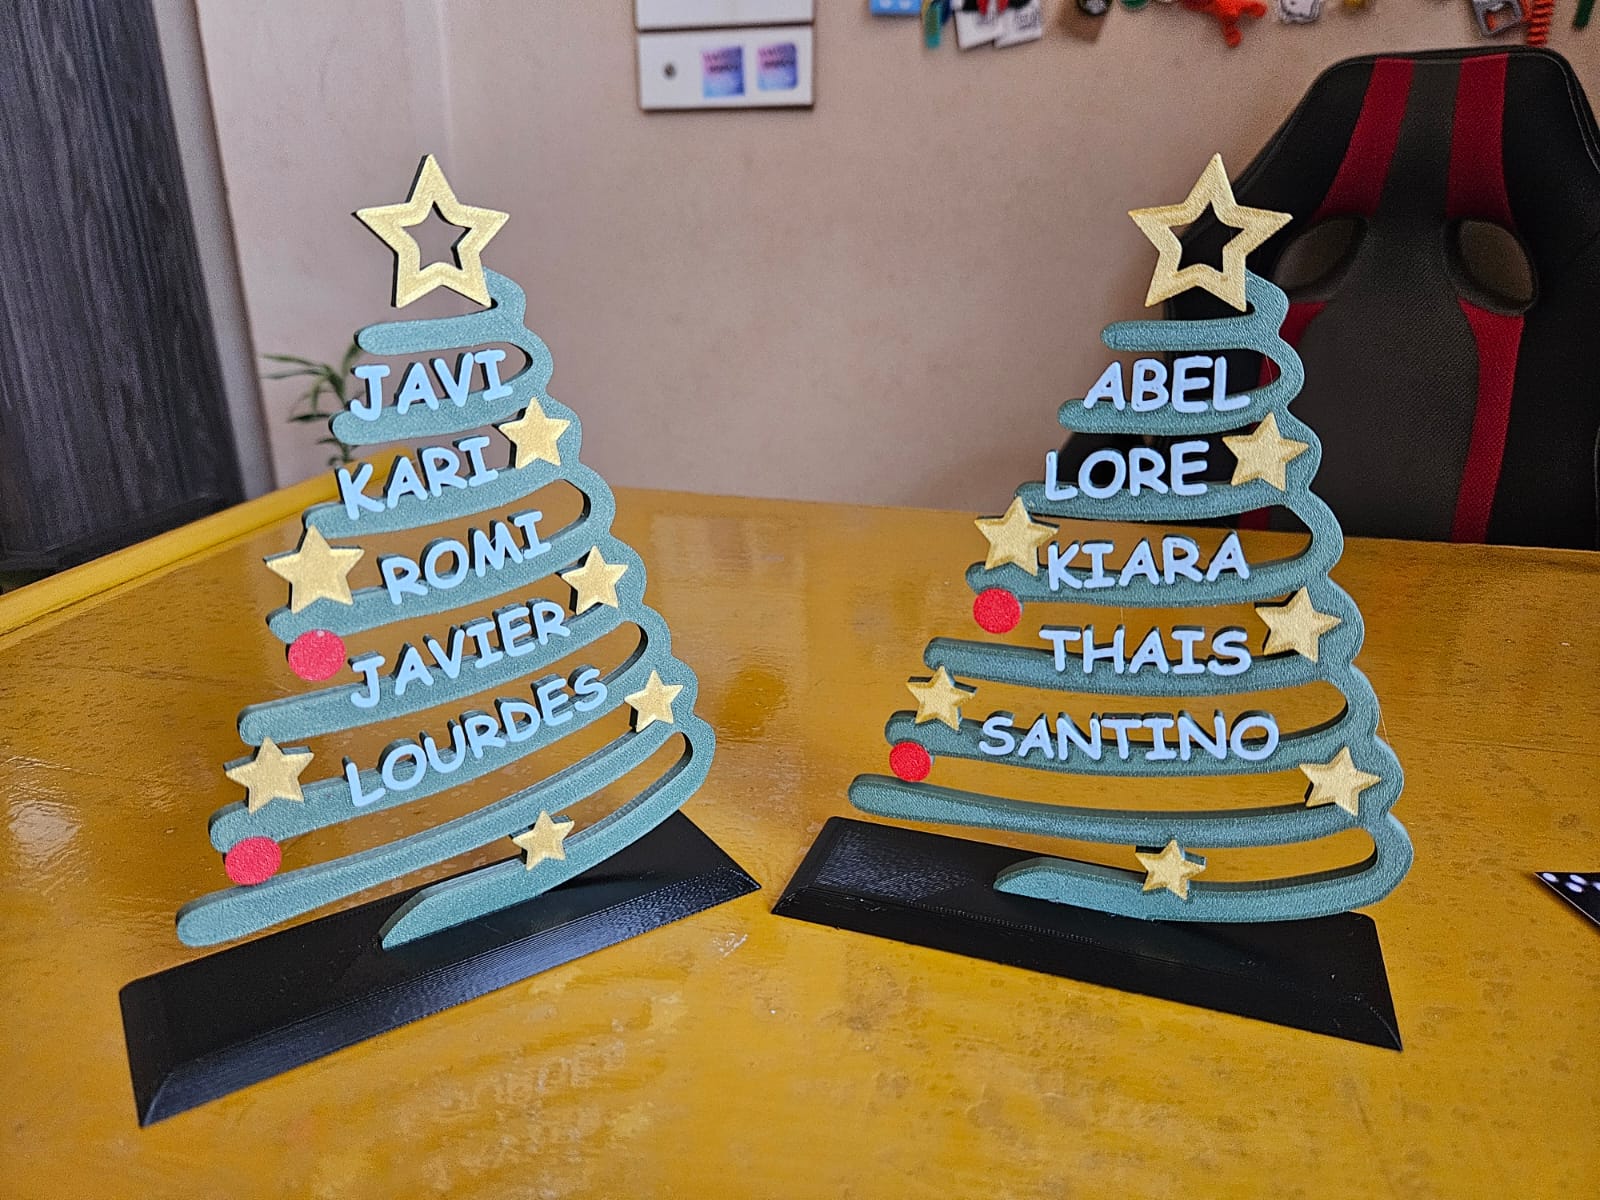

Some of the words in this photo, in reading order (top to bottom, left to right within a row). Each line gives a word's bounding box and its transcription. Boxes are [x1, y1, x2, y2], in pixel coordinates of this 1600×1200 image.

[349, 349, 514, 422] JAVI
[1082, 355, 1250, 414] ABEL
[338, 435, 499, 521] KARI
[1044, 440, 1210, 501] LORE
[381, 510, 551, 605] ROMI
[1047, 529, 1250, 592] KIARA
[350, 600, 571, 709] JAVIER
[1038, 629, 1252, 677] THAIS
[346, 667, 608, 808] LOURDES
[978, 715, 1280, 761] SANTINO
